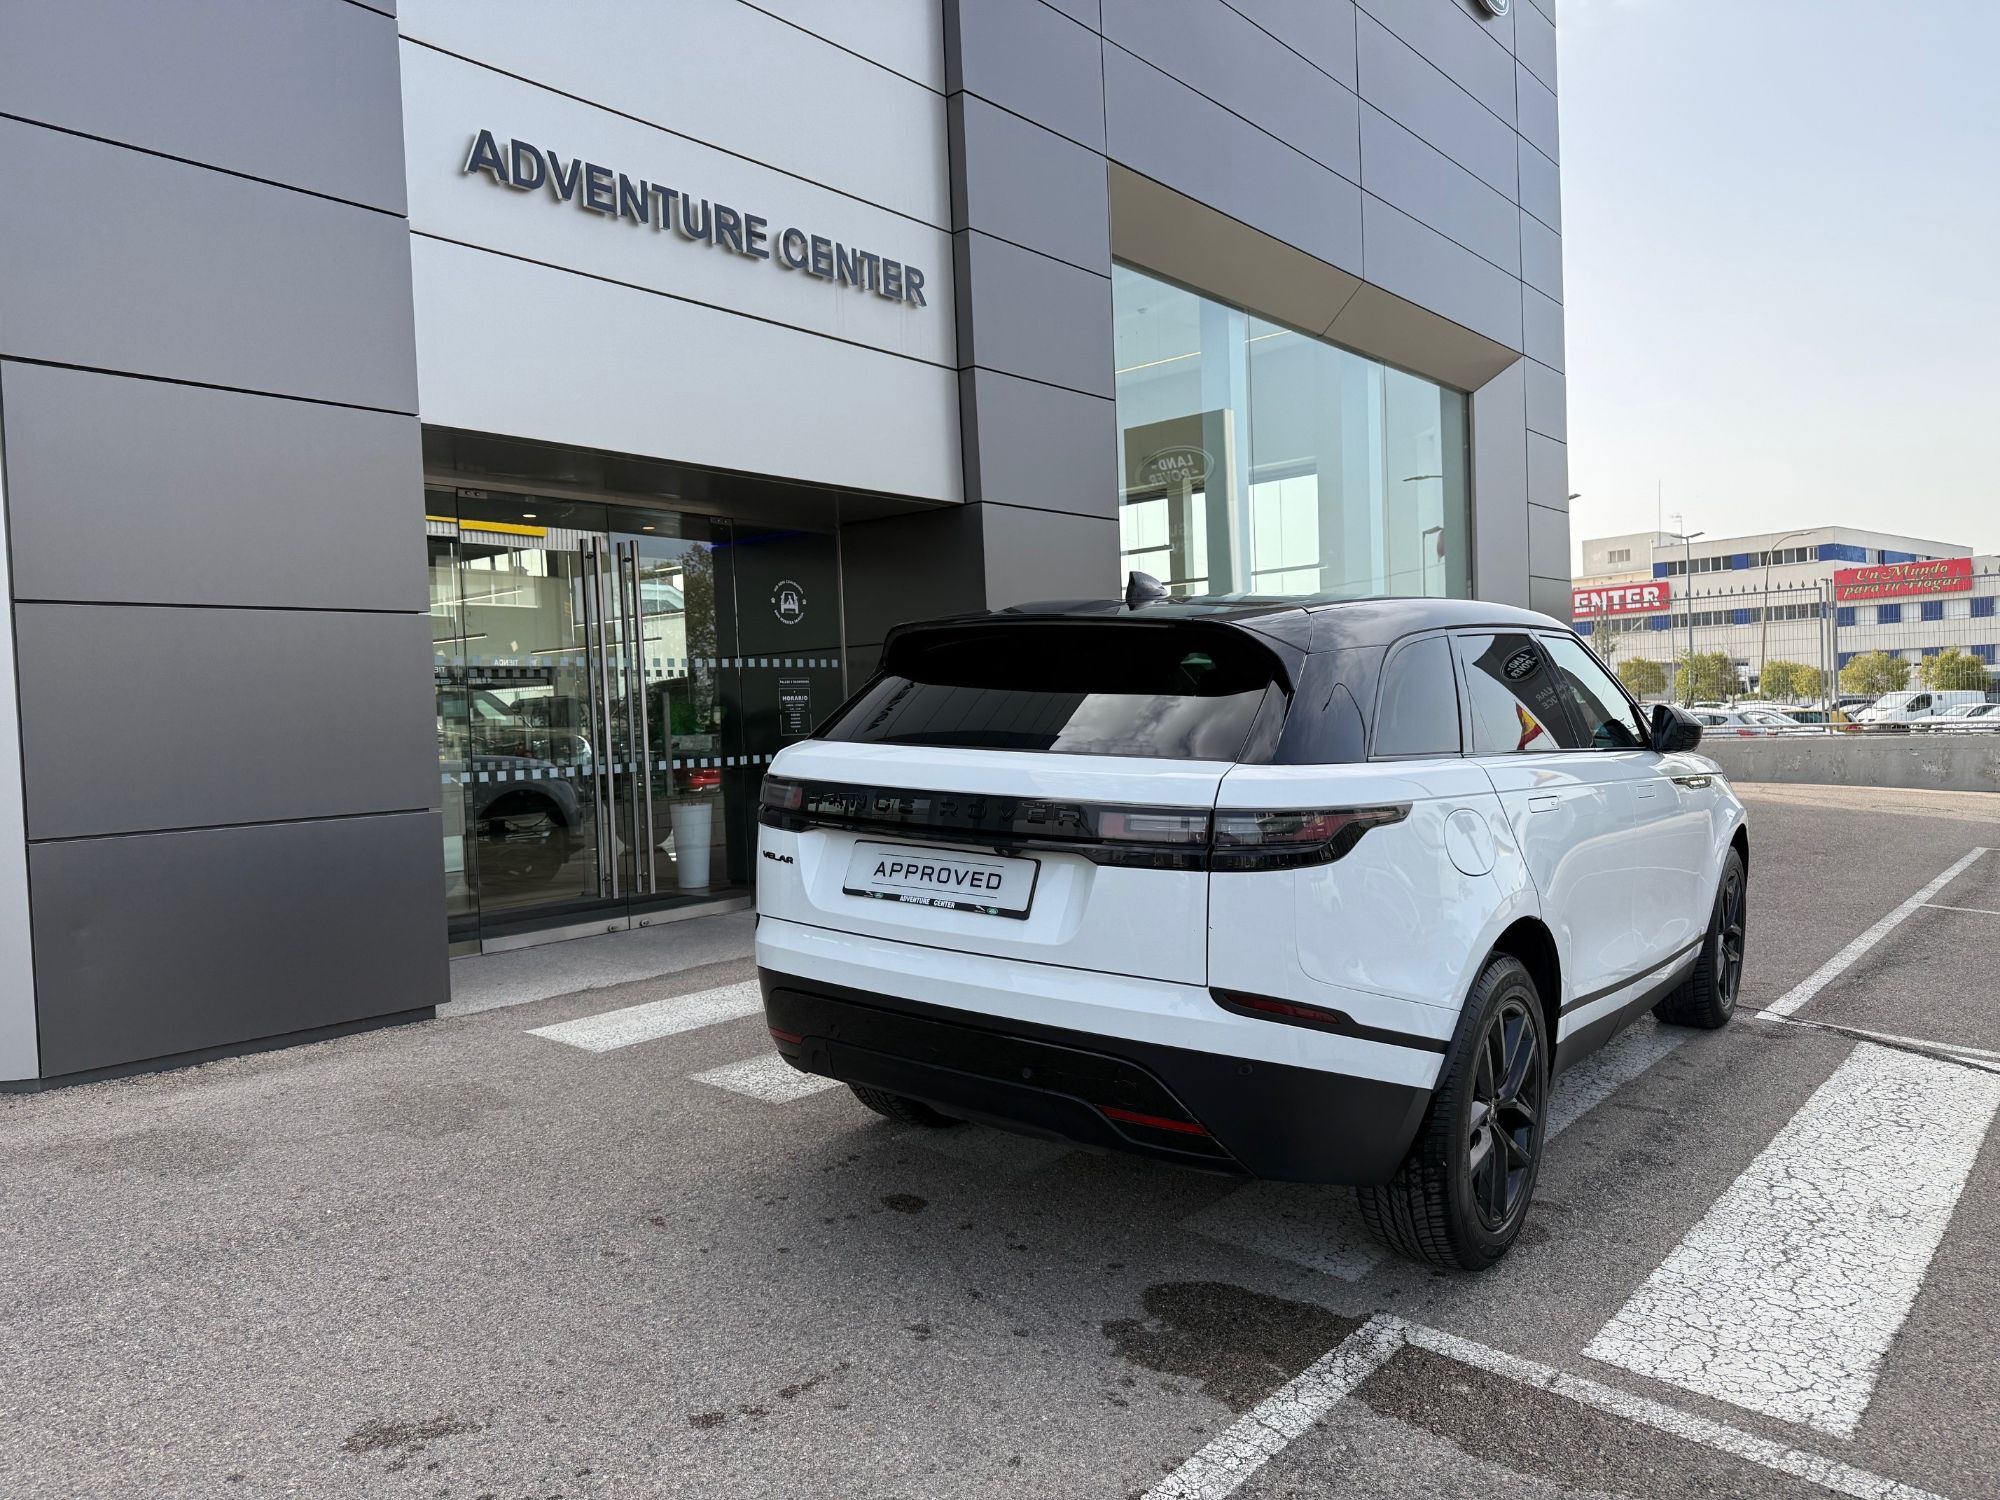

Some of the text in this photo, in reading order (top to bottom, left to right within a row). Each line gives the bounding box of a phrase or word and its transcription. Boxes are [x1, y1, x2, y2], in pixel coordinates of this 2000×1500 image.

[465, 129, 927, 306] ADVENTURE CENTER
[1856, 562, 1948, 580] Un Mundo
[940, 800, 1080, 827] ROVER
[763, 850, 794, 864] VELAR
[873, 861, 1002, 890] APPROVED
[900, 895, 956, 909] ADVENTURE CENTER
